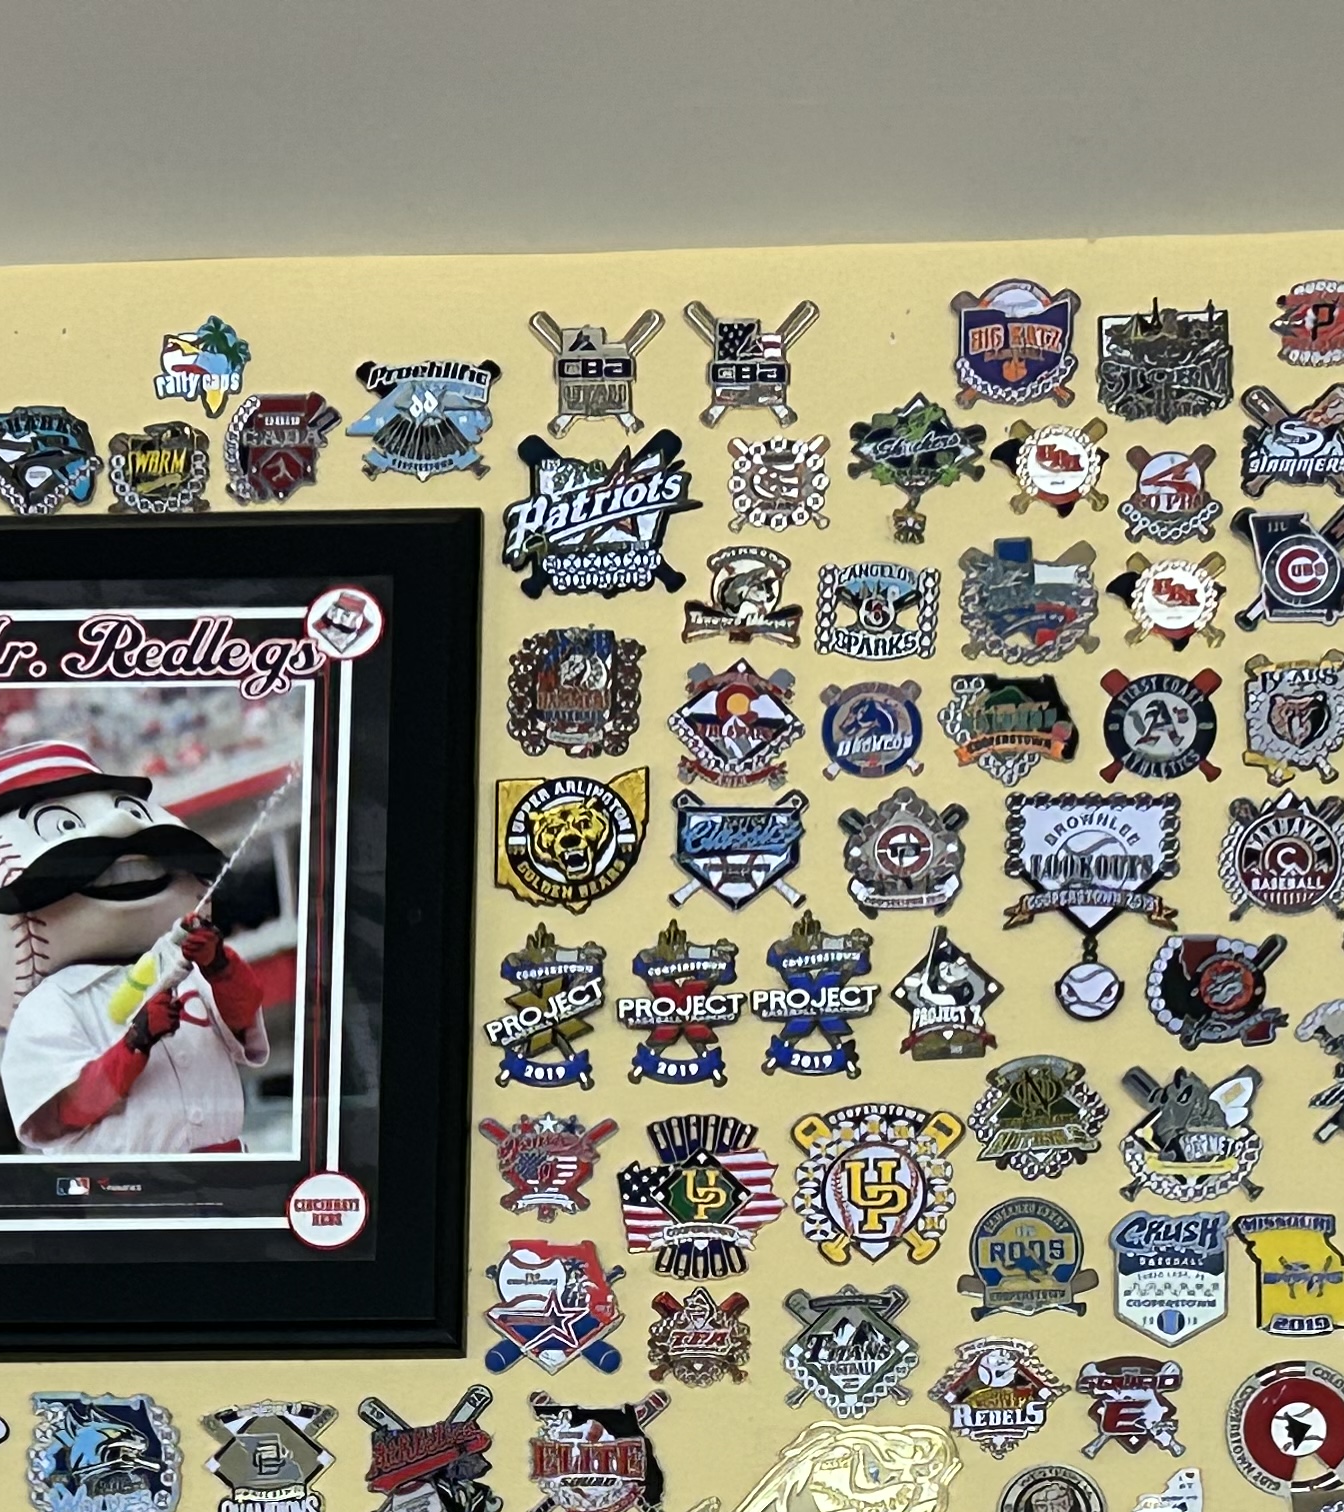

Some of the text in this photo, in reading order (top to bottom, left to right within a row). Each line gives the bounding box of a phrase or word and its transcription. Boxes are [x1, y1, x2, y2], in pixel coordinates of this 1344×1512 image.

[156, 371, 241, 398] rally caps
[506, 472, 684, 552] Patriots
[59, 612, 326, 701] Redlegs
[510, 779, 633, 842] UPPER ARLINGTON
[1043, 810, 1142, 848] BROWNLEE
[516, 861, 627, 899] GOLDEN BEARS
[1030, 854, 1154, 881] LOOKOUTS
[486, 976, 605, 1043] PROJECT
[618, 993, 744, 1019] PROJECT
[752, 985, 879, 1010] PROJECT
[911, 1006, 969, 1030] PROJECT
[523, 1065, 567, 1081] 2019
[656, 1061, 699, 1078] 2019
[789, 1053, 833, 1069] 2019
[843, 1157, 910, 1236] UP
[1117, 1215, 1222, 1253] CRUSH
[1272, 1317, 1330, 1331] 2019
[951, 1402, 1047, 1429] REBELS
